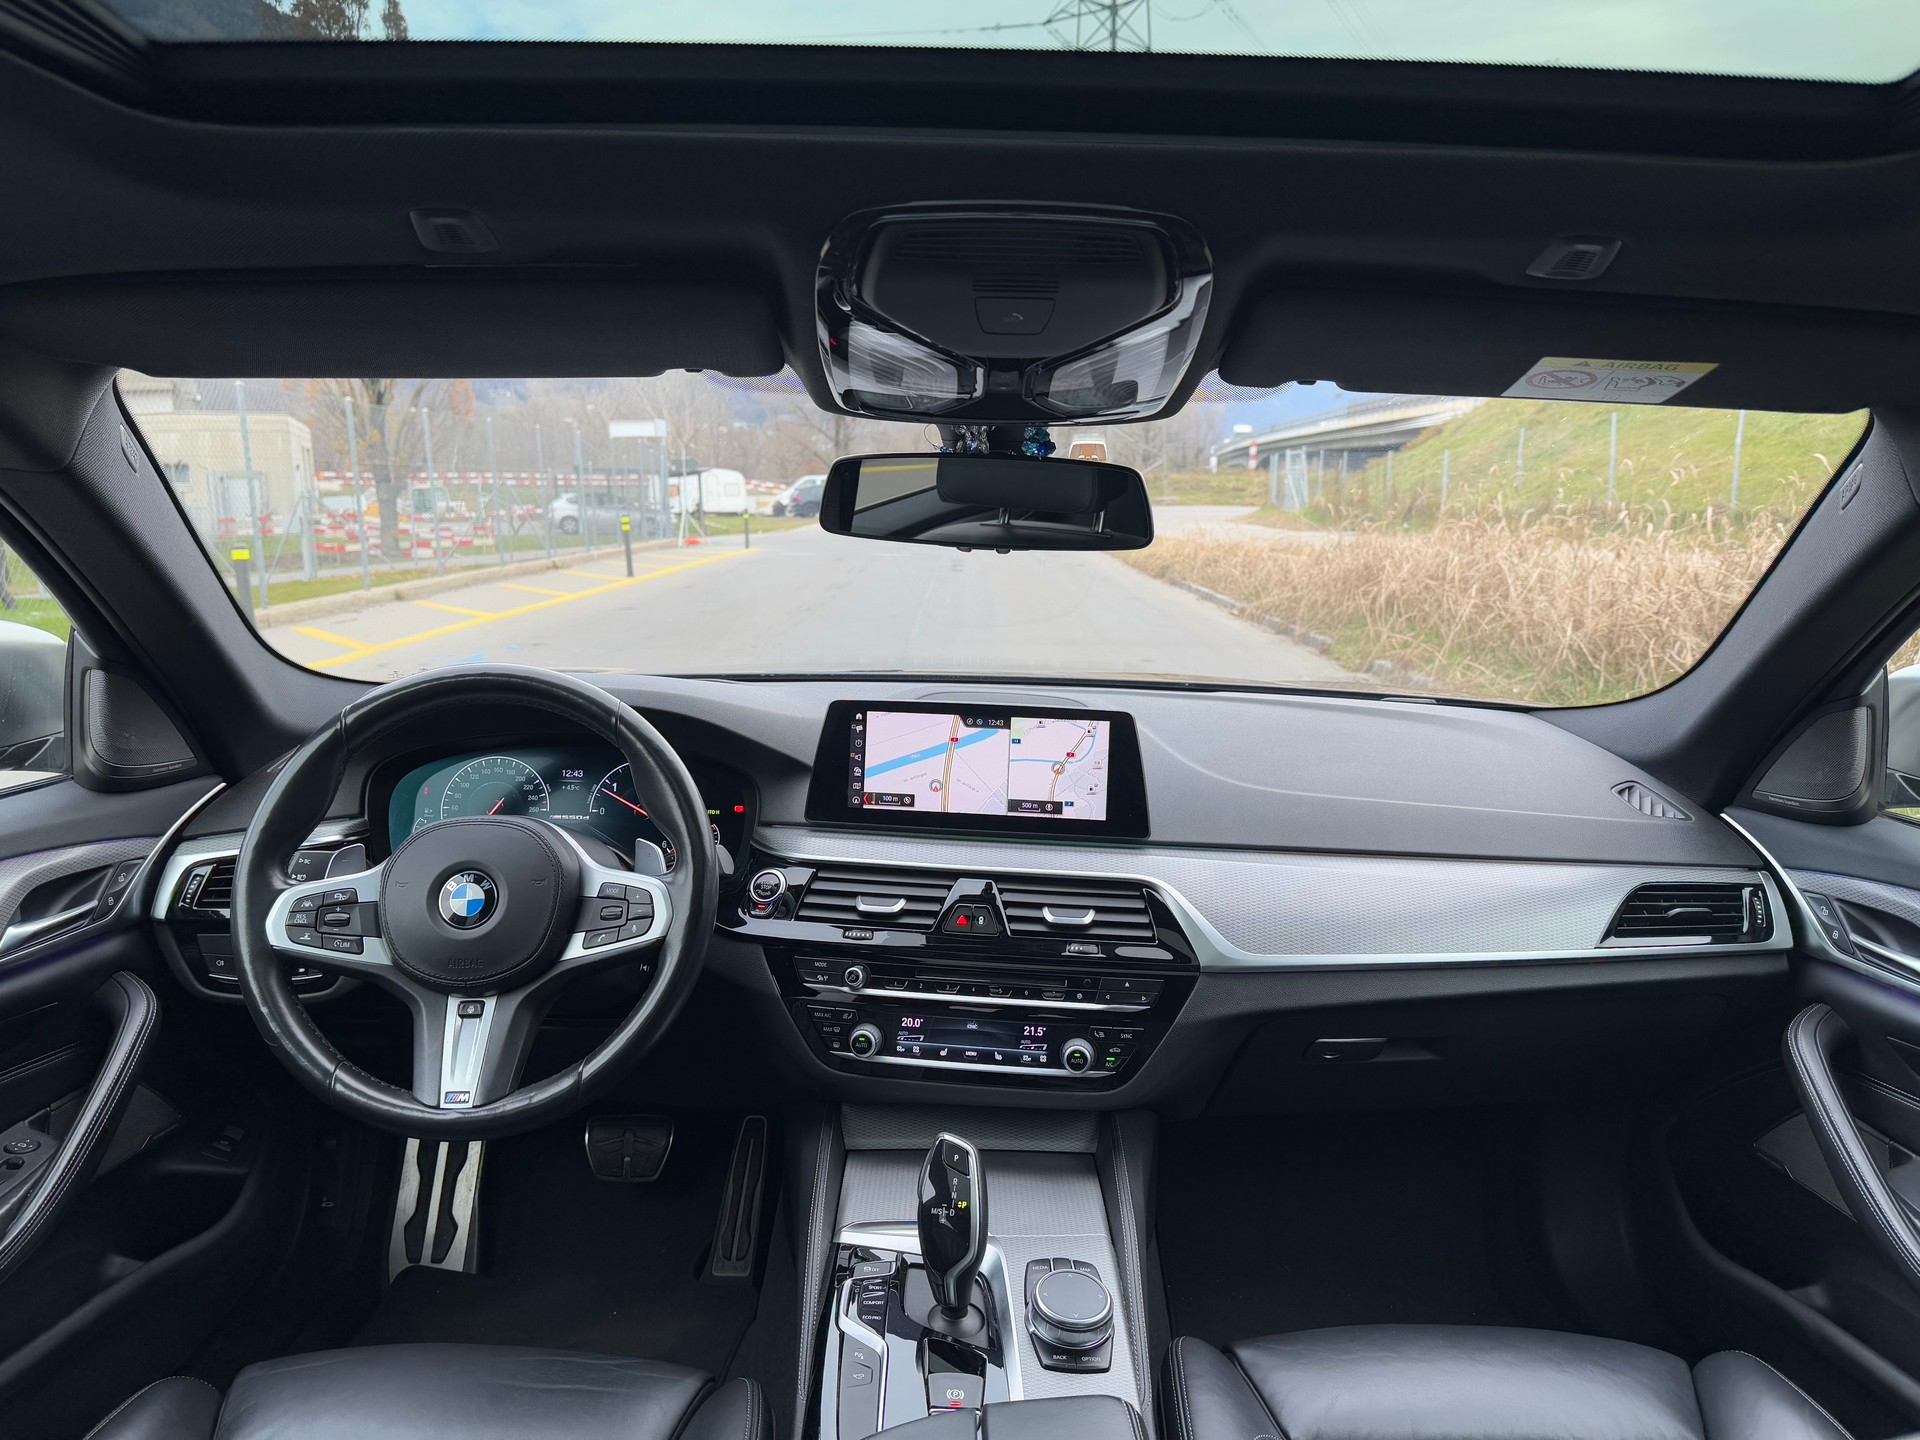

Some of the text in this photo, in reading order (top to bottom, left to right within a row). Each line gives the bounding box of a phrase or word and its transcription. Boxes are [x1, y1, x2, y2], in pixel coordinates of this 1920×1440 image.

[1603, 361, 1681, 371] AIRBAG
[561, 769, 584, 778] 12:43
[612, 783, 617, 792] 1
[600, 807, 605, 815] 0
[661, 840, 667, 849] 6
[446, 873, 492, 892] BMW
[448, 959, 484, 969] AIRBAG
[952, 1178, 958, 1186] R
[951, 1191, 957, 1199] N
[961, 1201, 967, 1209] P
[931, 1207, 942, 1215] M/S
[949, 1208, 955, 1217] D
